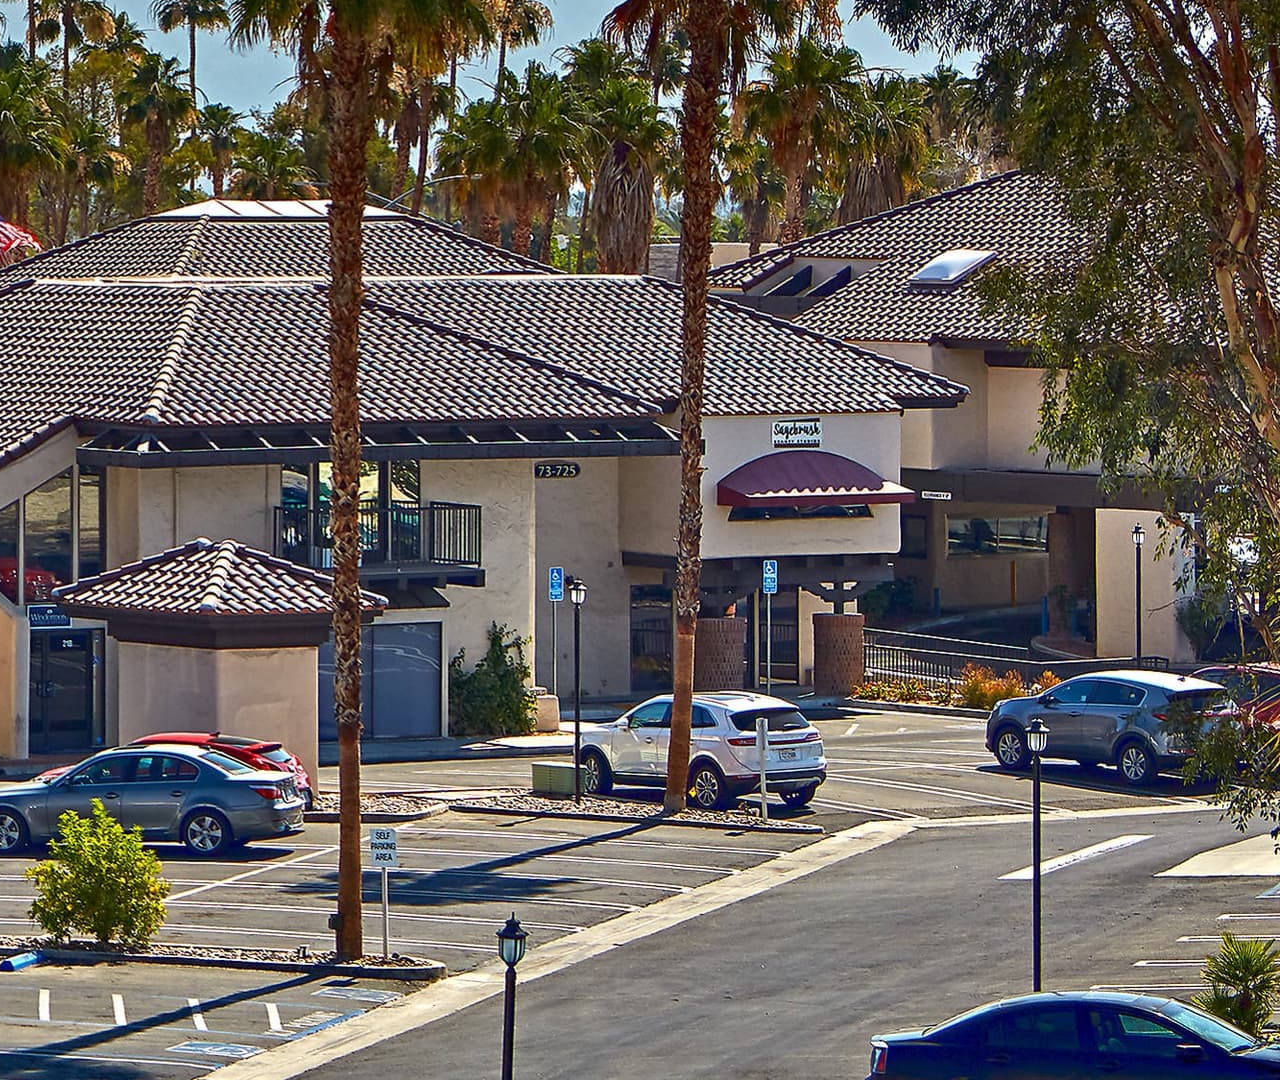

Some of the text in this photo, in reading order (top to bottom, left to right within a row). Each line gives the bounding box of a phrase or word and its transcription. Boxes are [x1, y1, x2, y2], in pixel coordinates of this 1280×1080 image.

[538, 465, 576, 477] 73-725
[375, 831, 391, 840] SELF
[370, 842, 397, 851] PARKING
[375, 853, 393, 862] AREA
